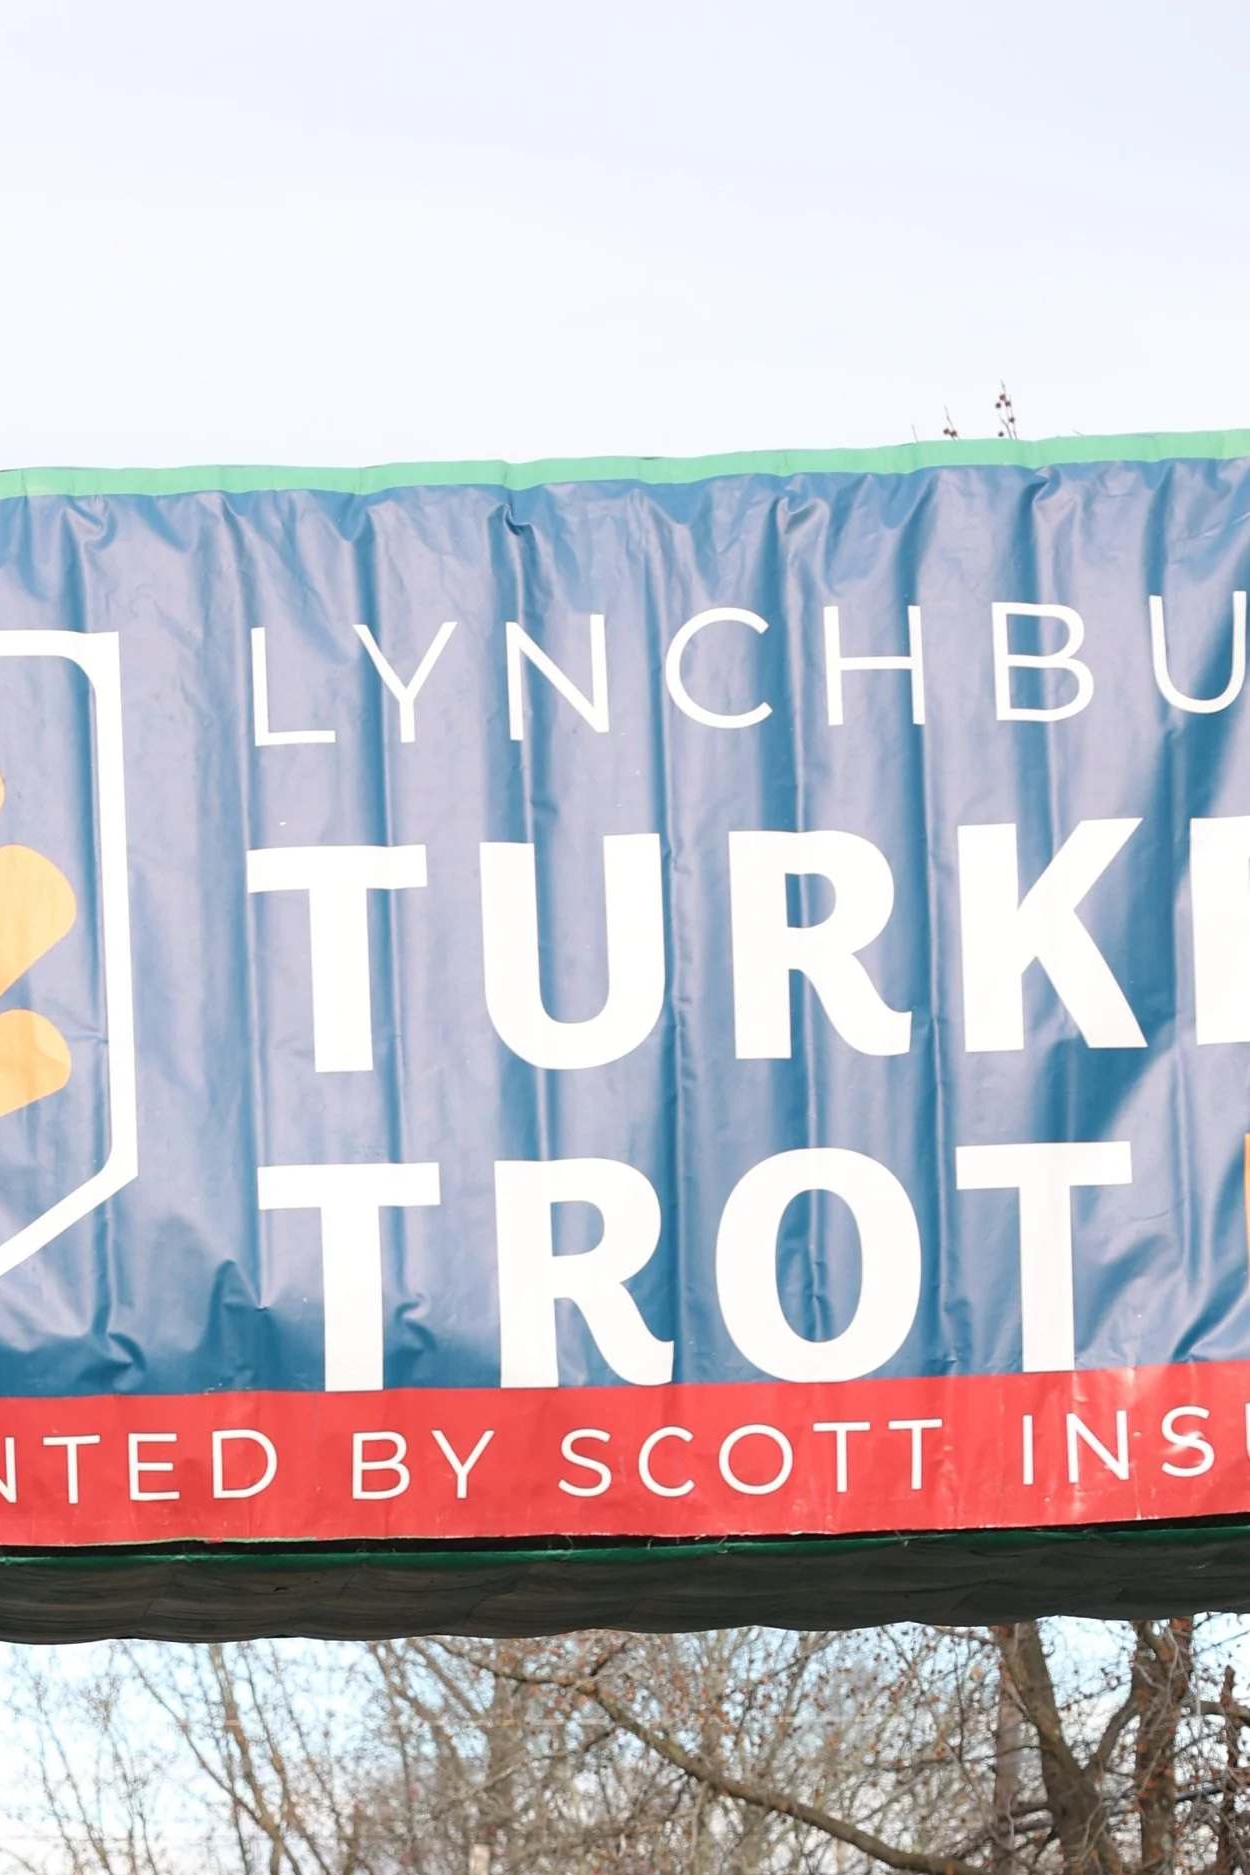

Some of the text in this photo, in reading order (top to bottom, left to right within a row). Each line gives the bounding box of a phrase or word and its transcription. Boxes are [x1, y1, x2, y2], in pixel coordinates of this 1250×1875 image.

[250, 590, 1250, 747] LYNCHBU
[257, 1140, 1132, 1393] TROT
[352, 1430, 495, 1500] BY
[558, 1419, 943, 1498] SCOTT
[1022, 1405, 1250, 1486] INS
